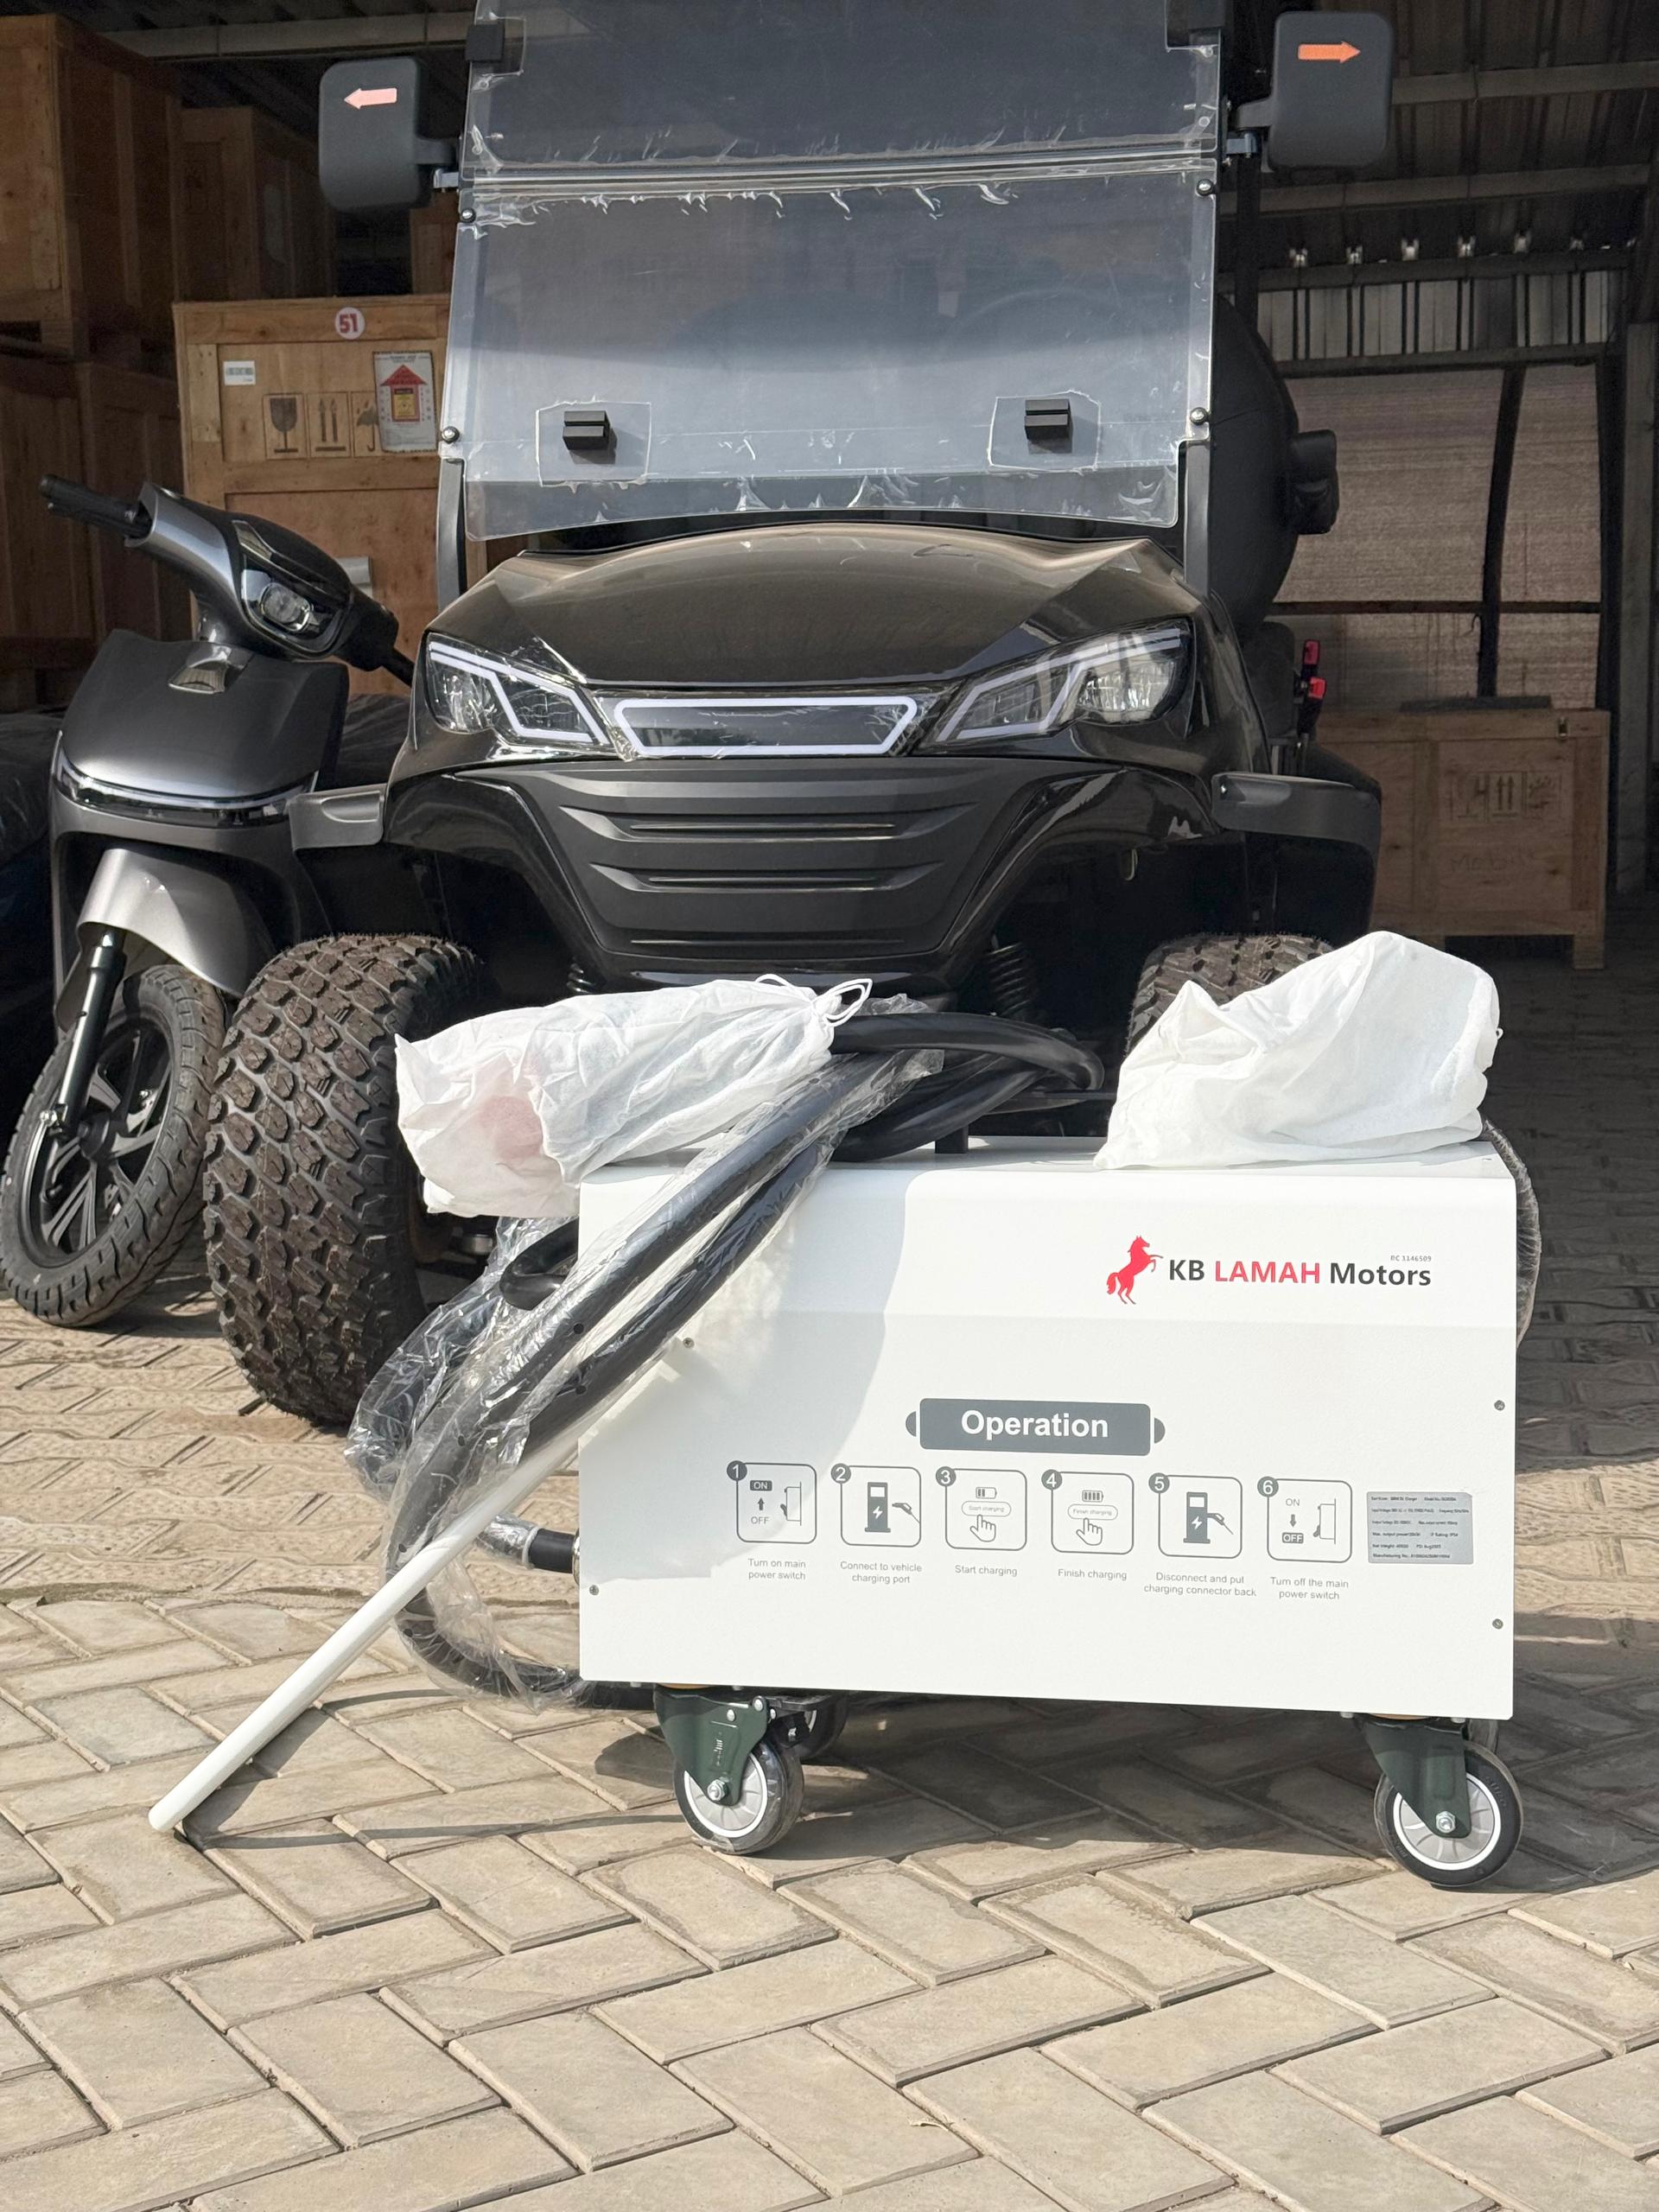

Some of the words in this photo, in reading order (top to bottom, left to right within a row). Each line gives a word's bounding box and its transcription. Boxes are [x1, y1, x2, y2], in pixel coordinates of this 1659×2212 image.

[340, 313, 359, 334] 51
[1170, 1260, 1205, 1281] KB
[1216, 1261, 1319, 1283] LAMAH
[1331, 1262, 1431, 1286] Motors
[962, 1410, 1108, 1440] Operation
[733, 1465, 739, 1478] 1
[836, 1467, 846, 1481] 2
[941, 1470, 950, 1484] 3
[1046, 1473, 1057, 1489] 4
[1155, 1477, 1164, 1491] 5
[1263, 1480, 1273, 1494] 6
[747, 1558, 767, 1567] Turn
[841, 1561, 877, 1570] Connect
[891, 1563, 922, 1572] vehicle
[955, 1565, 976, 1573] Start
[979, 1567, 1017, 1577] charging
[1088, 1570, 1127, 1580] charging
[852, 1573, 890, 1585] charging
[1156, 1573, 1207, 1582] Disconnect
[1230, 1576, 1243, 1585] put
[1144, 1584, 1183, 1595] charging
